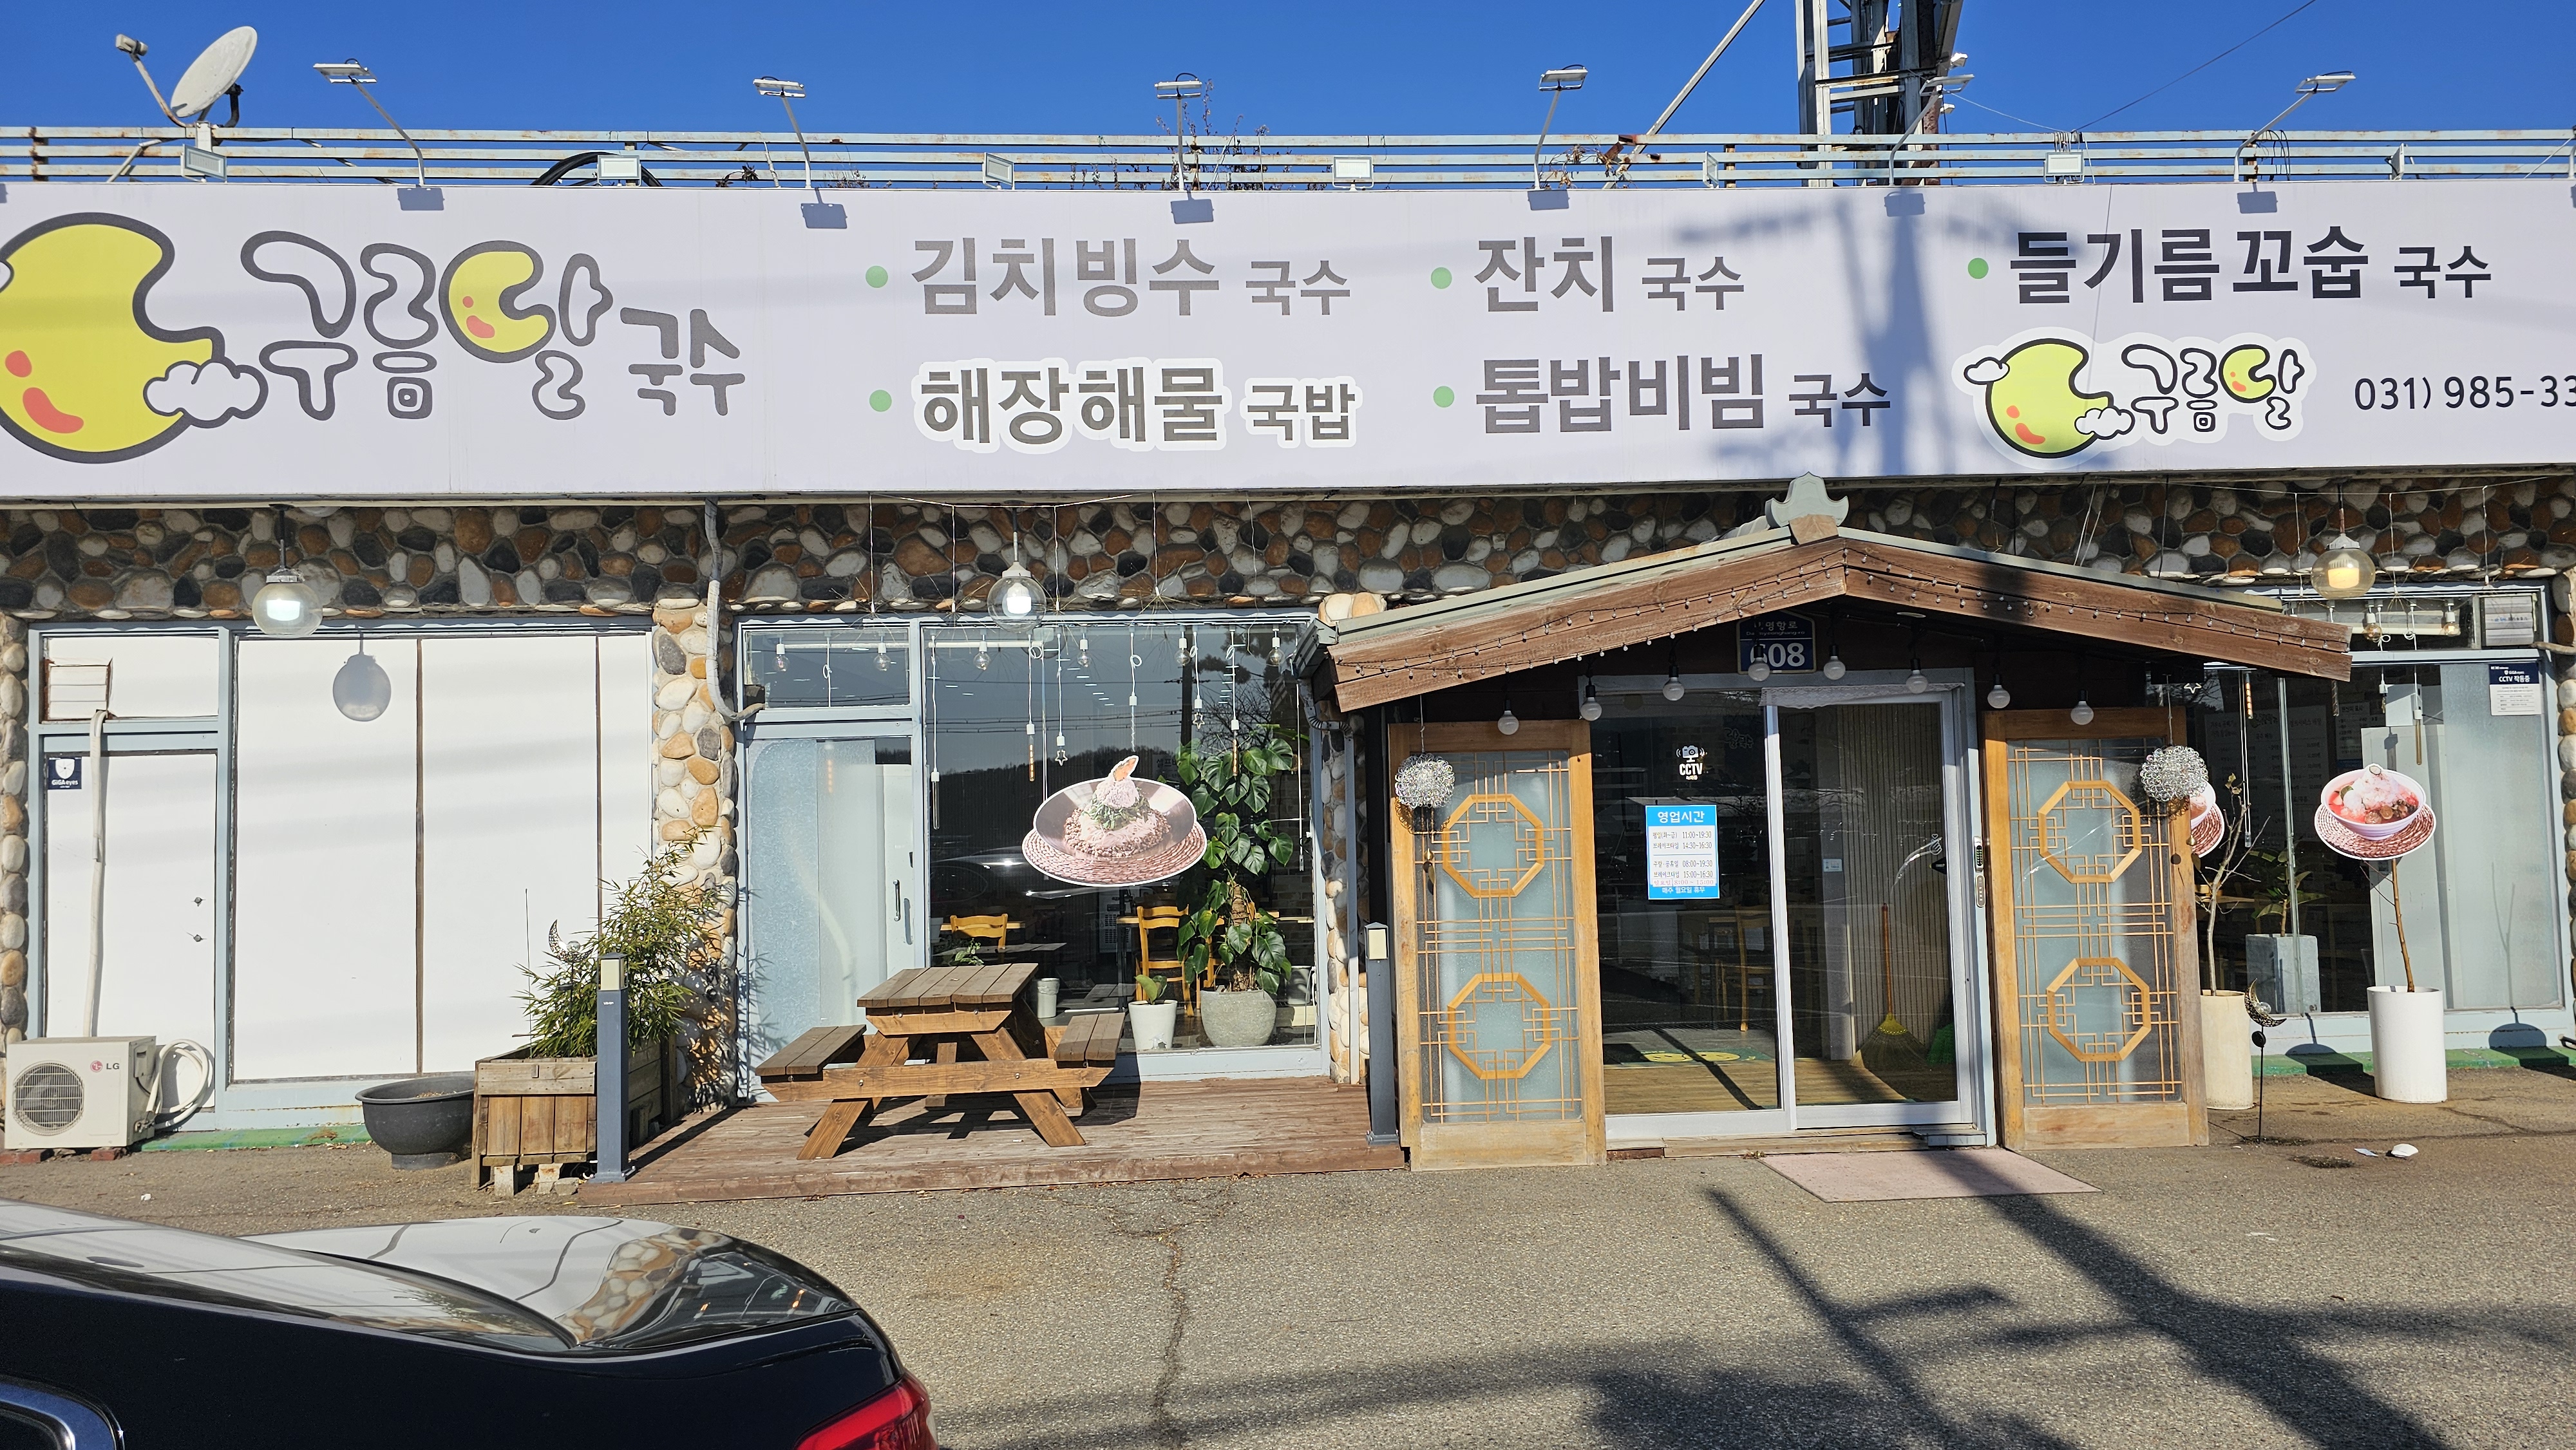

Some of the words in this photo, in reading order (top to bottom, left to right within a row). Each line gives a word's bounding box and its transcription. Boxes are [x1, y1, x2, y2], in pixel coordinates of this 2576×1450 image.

[911, 237, 1220, 317] 김치빙수
[1245, 259, 1351, 315] 국수
[1473, 236, 1615, 312] 잔치
[1642, 256, 1745, 311] 국수
[2394, 245, 2492, 299] 국수
[620, 308, 746, 416] 국수
[921, 366, 1223, 445] 해장해물
[1246, 383, 1356, 441] 국밥
[1475, 353, 1765, 434] 톱밥비빔
[1788, 372, 1891, 428] 국수
[2354, 376, 2431, 410] 031)
[1679, 762, 1703, 776] CCTV
[1657, 811, 1705, 824] 영업시간
[1682, 831, 1712, 839] 11:00~19:30
[1662, 886, 1674, 894] 매주
